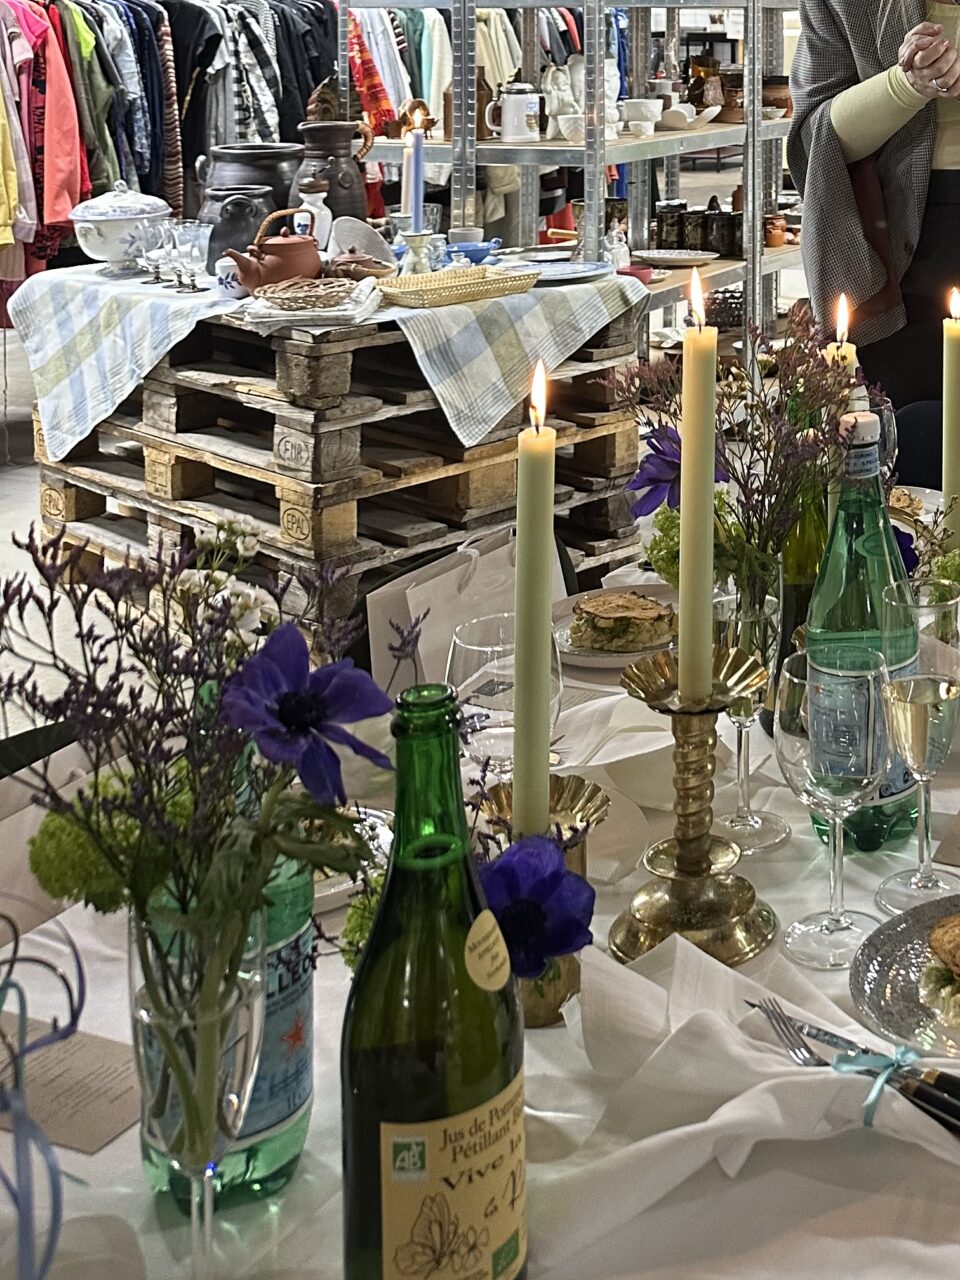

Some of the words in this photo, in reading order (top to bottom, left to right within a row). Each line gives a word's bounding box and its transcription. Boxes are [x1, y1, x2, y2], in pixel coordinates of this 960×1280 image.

[44, 492, 63, 512] EPAL
[286, 512, 307, 536] EPAL
[439, 1127, 465, 1153] Jus
[468, 1117, 487, 1137] de
[452, 1118, 510, 1164] Pétillant
[394, 1143, 422, 1170] AB
[441, 1153, 504, 1190] Vive
